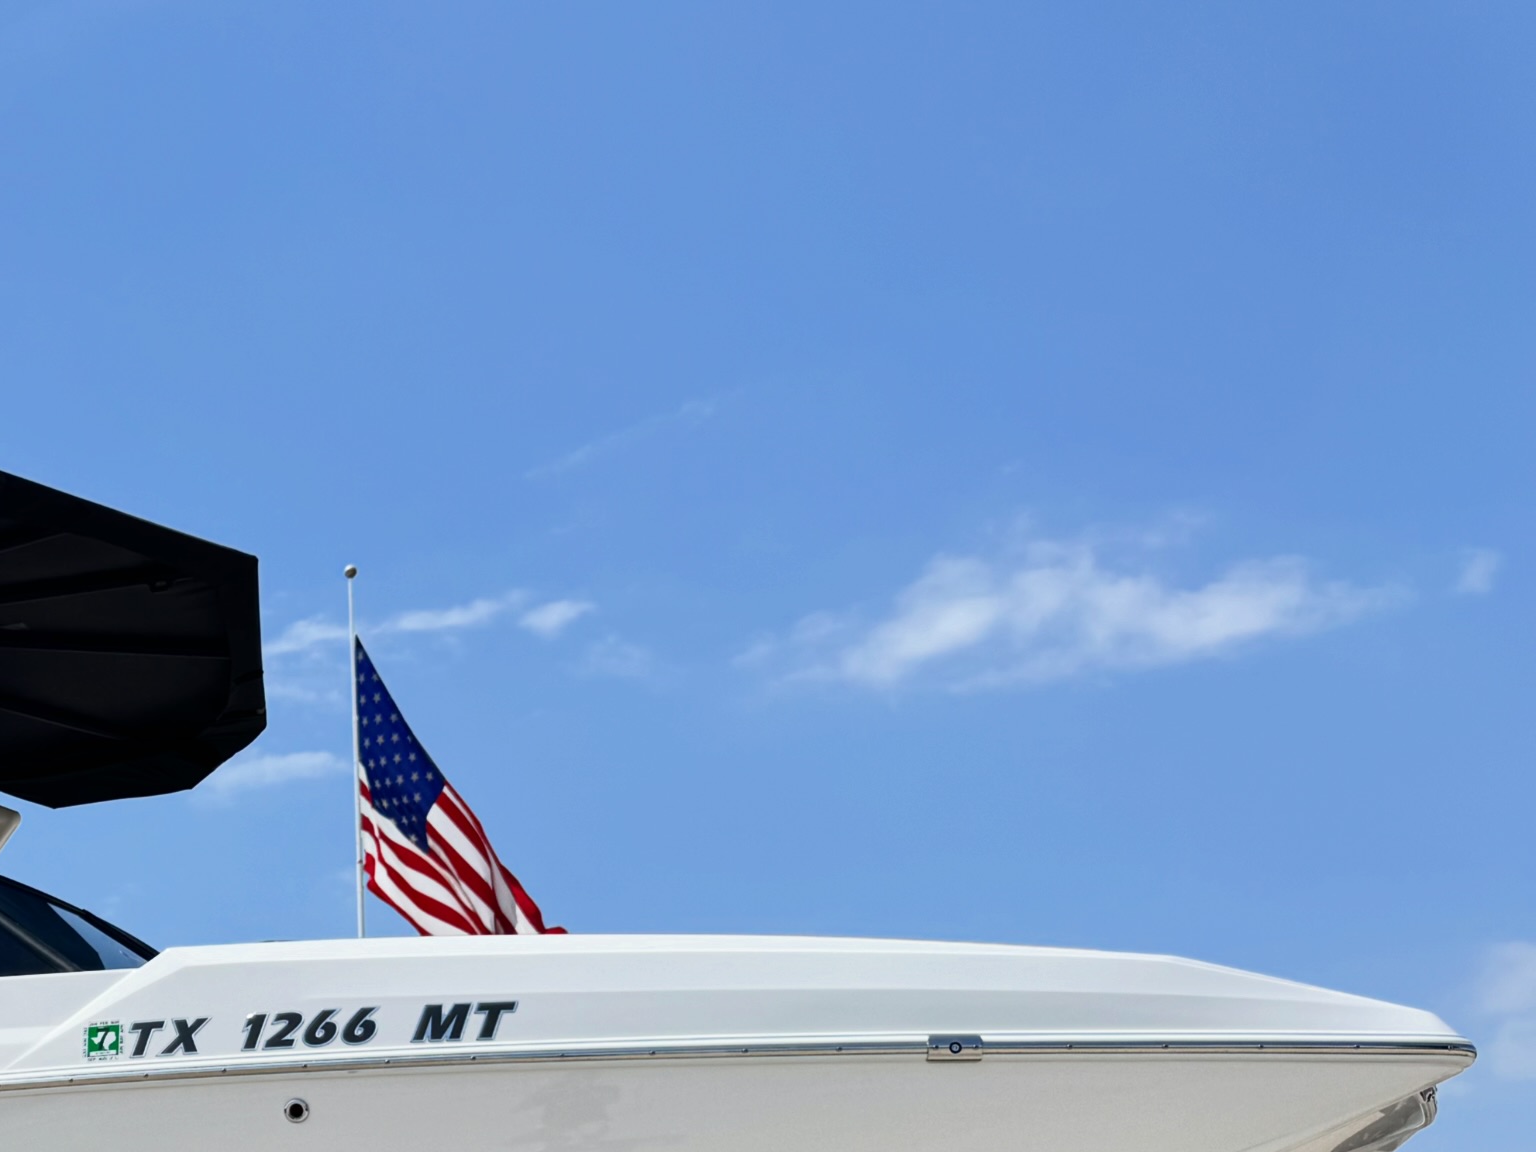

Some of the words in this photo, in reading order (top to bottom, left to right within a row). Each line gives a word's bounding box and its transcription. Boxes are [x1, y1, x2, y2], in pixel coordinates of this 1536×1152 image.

[127, 1017, 212, 1058] TX
[240, 1006, 383, 1050] 1266
[409, 1001, 518, 1043] MT
